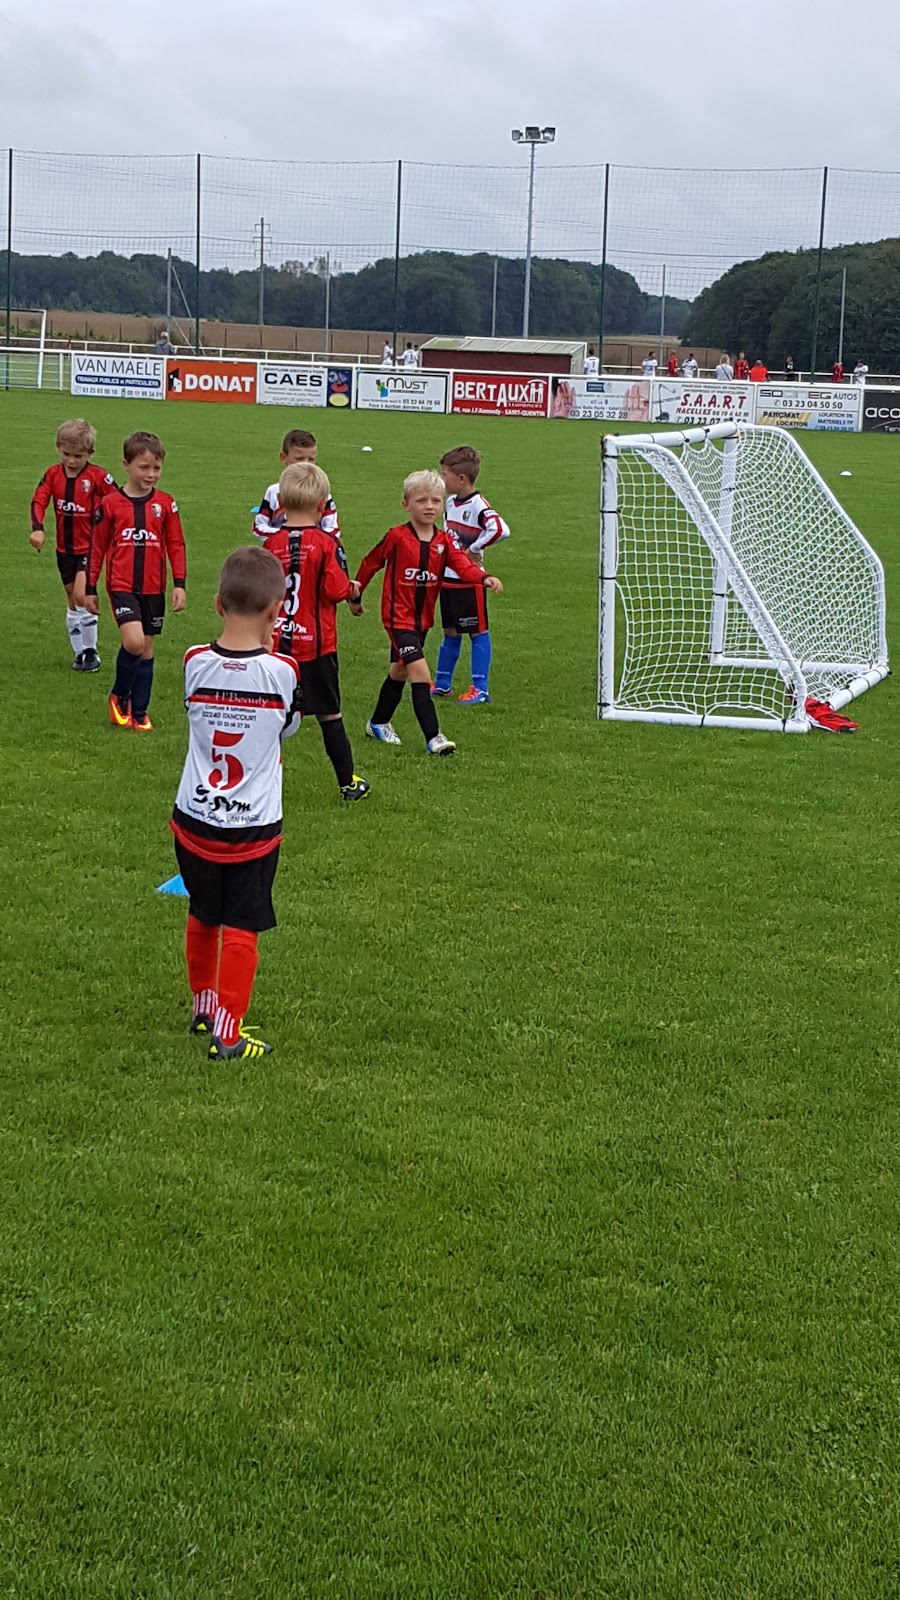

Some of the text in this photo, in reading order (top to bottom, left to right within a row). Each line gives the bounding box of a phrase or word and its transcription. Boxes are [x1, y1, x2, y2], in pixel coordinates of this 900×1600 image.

[77, 358, 161, 376] VAN MAELE
[185, 374, 255, 393] DONAT
[264, 372, 323, 387] CAES
[454, 381, 530, 407] BERTAUX
[681, 393, 747, 409] S.A.A.R.T
[833, 392, 858, 400] AUTOS
[676, 407, 712, 415] NACELLES
[795, 400, 805, 408] 23
[832, 401, 843, 409] 50
[684, 416, 694, 424] 03
[284, 572, 301, 615] 3
[208, 729, 245, 790] 5
